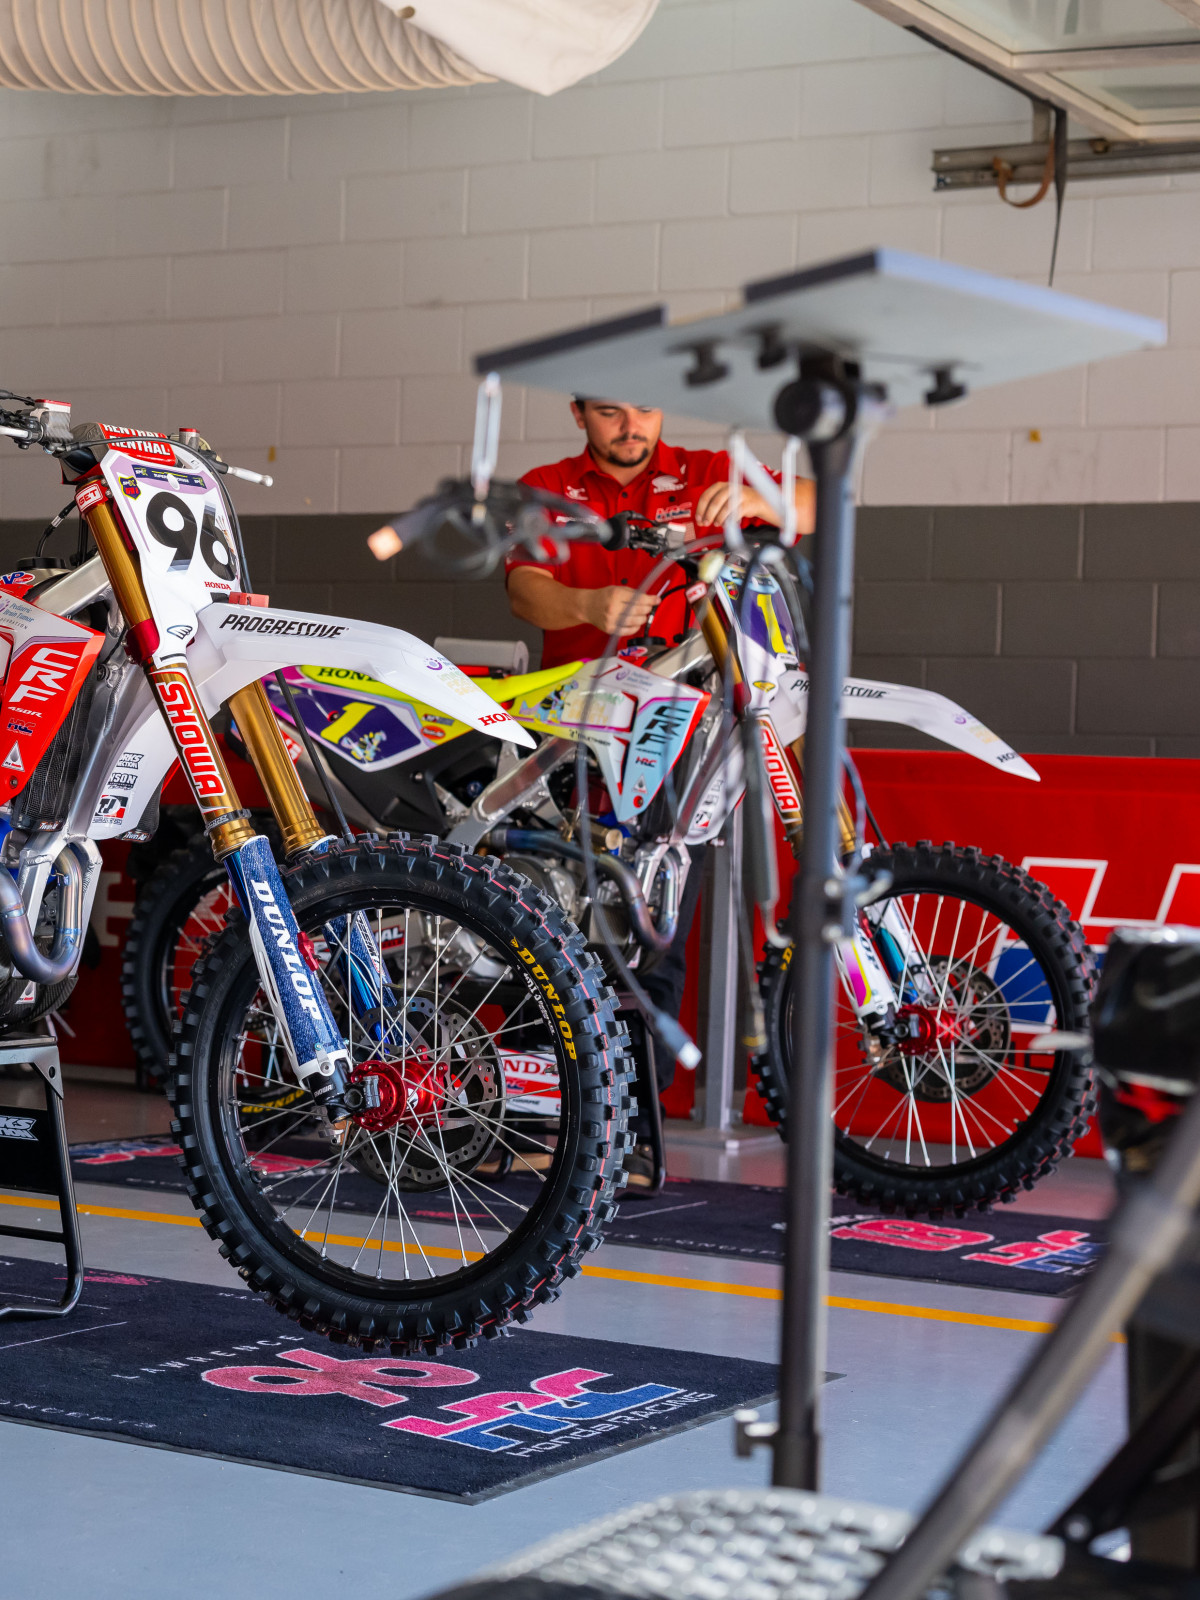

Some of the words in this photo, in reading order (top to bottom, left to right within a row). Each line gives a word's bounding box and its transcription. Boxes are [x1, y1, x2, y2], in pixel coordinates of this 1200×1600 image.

[146, 491, 238, 581] 96
[2, 571, 25, 585] VP
[204, 581, 232, 591] HONDA
[219, 613, 347, 638] PROGRESSIVE
[9, 647, 80, 703] CRF
[318, 668, 374, 682] HON
[791, 679, 888, 699] PRESSIVE
[8, 706, 43, 718] 450R
[320, 702, 376, 744] 1
[478, 713, 515, 726] HON
[155, 681, 227, 799] SHOWA
[250, 879, 323, 1021] DUNLOP
[517, 947, 577, 1061] DUNLOP
[503, 1058, 560, 1078] NDA
[111, 1334, 305, 1381] LAWRENCE
[201, 1347, 481, 1408] 96
[381, 1366, 688, 1453] HRC
